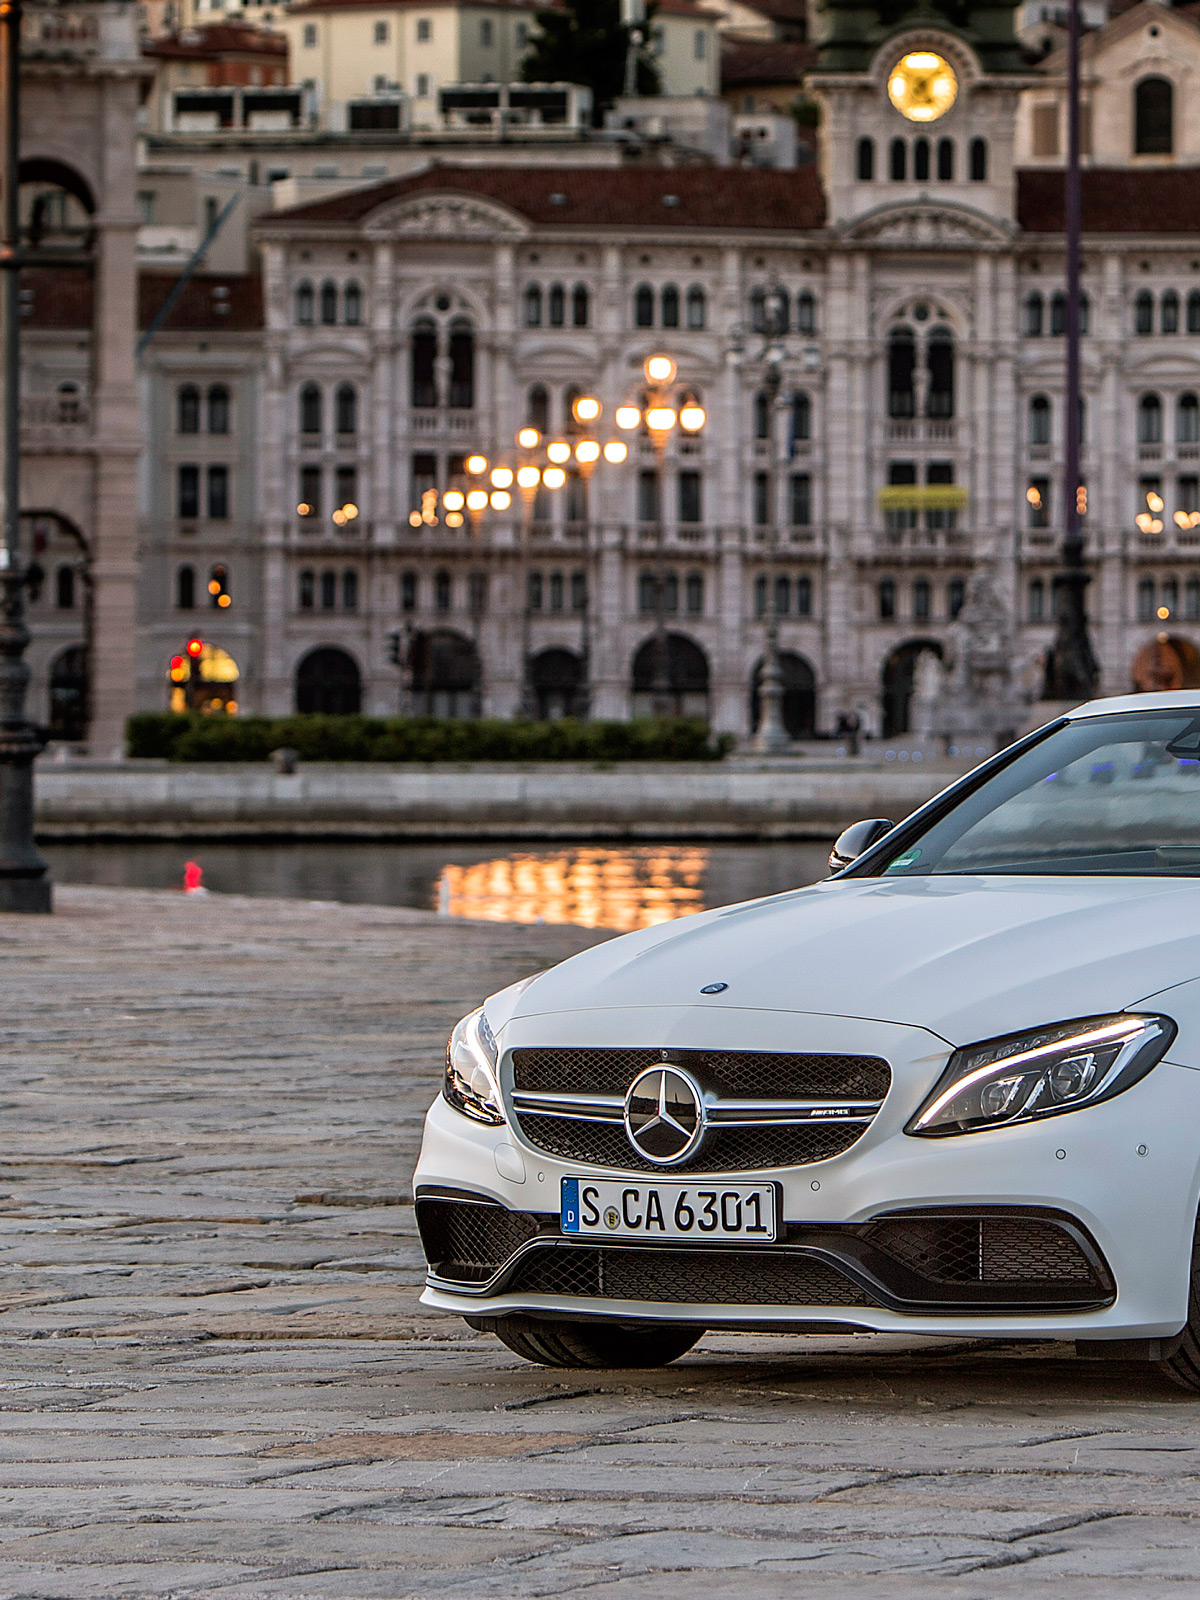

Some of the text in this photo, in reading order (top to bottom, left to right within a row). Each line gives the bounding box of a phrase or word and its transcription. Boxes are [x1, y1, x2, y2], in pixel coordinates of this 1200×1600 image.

[567, 1211, 576, 1222] D
[581, 1186, 768, 1233] S CA 6301
